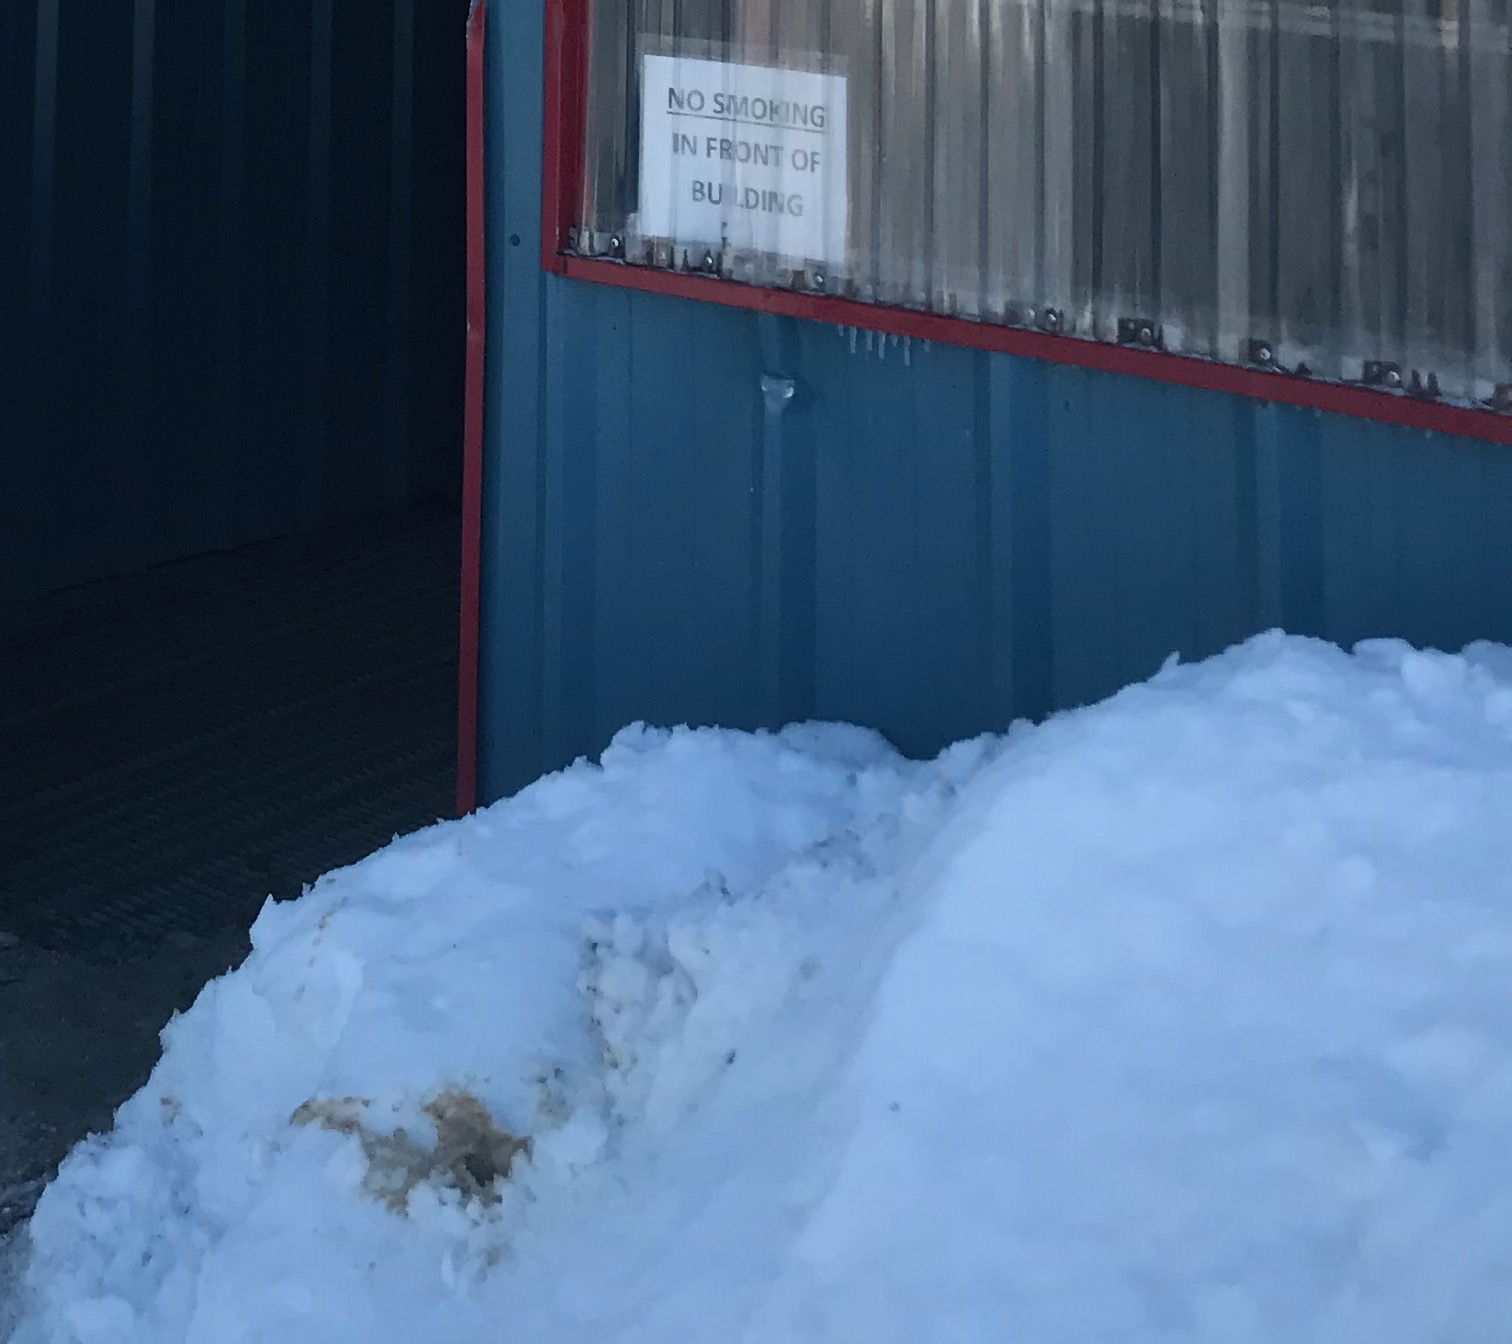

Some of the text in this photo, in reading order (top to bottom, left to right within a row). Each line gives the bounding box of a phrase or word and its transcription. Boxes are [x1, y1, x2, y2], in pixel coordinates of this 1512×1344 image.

[668, 87, 825, 128] NO SMOKNG
[672, 132, 821, 173] IN FRONT OF
[692, 180, 804, 217] BUDING
